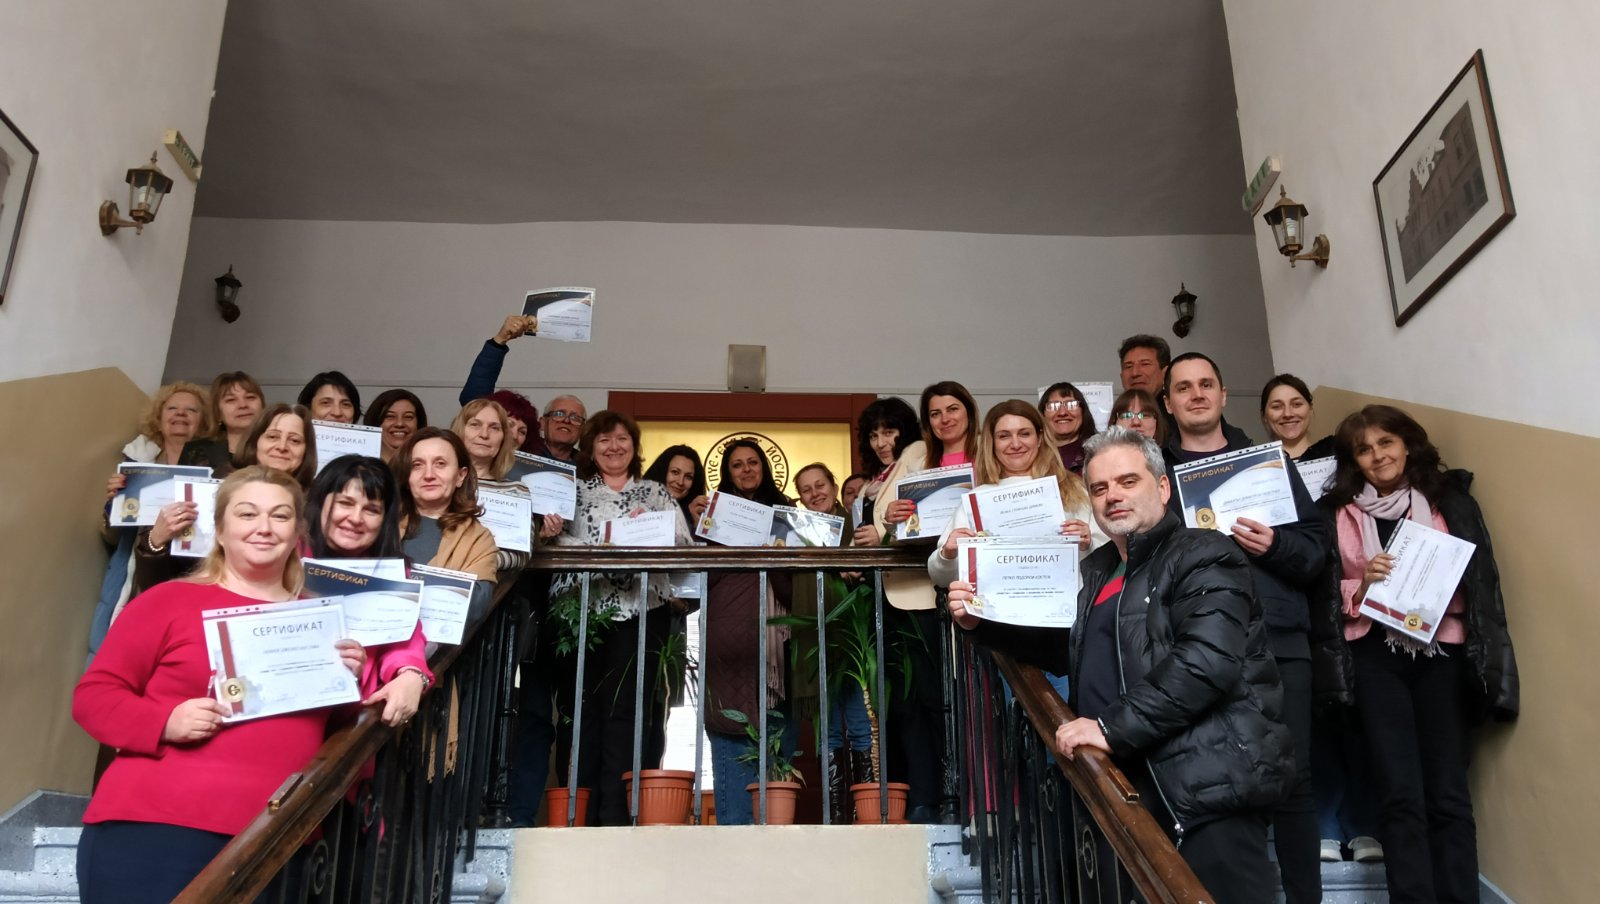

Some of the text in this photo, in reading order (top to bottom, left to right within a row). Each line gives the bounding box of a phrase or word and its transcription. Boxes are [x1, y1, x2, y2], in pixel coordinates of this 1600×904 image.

[315, 434, 366, 445] СЕРТИФИКАТ
[1183, 464, 1234, 483] СЕРТИФИКАТ
[900, 481, 939, 492] СЕРТИФИКАТ
[992, 485, 1044, 503] СЕРТИФИКАТ
[480, 496, 518, 509] РТИФИКАТ
[728, 500, 766, 516] СЕРТИФИКАТ
[622, 515, 664, 527] СЕРТИФИКАТ
[996, 554, 1060, 565] СЕРТИФИКАТ
[307, 567, 369, 586] СЕРТИФИКАТ
[252, 620, 324, 637] СЕРТИФИКАТ
